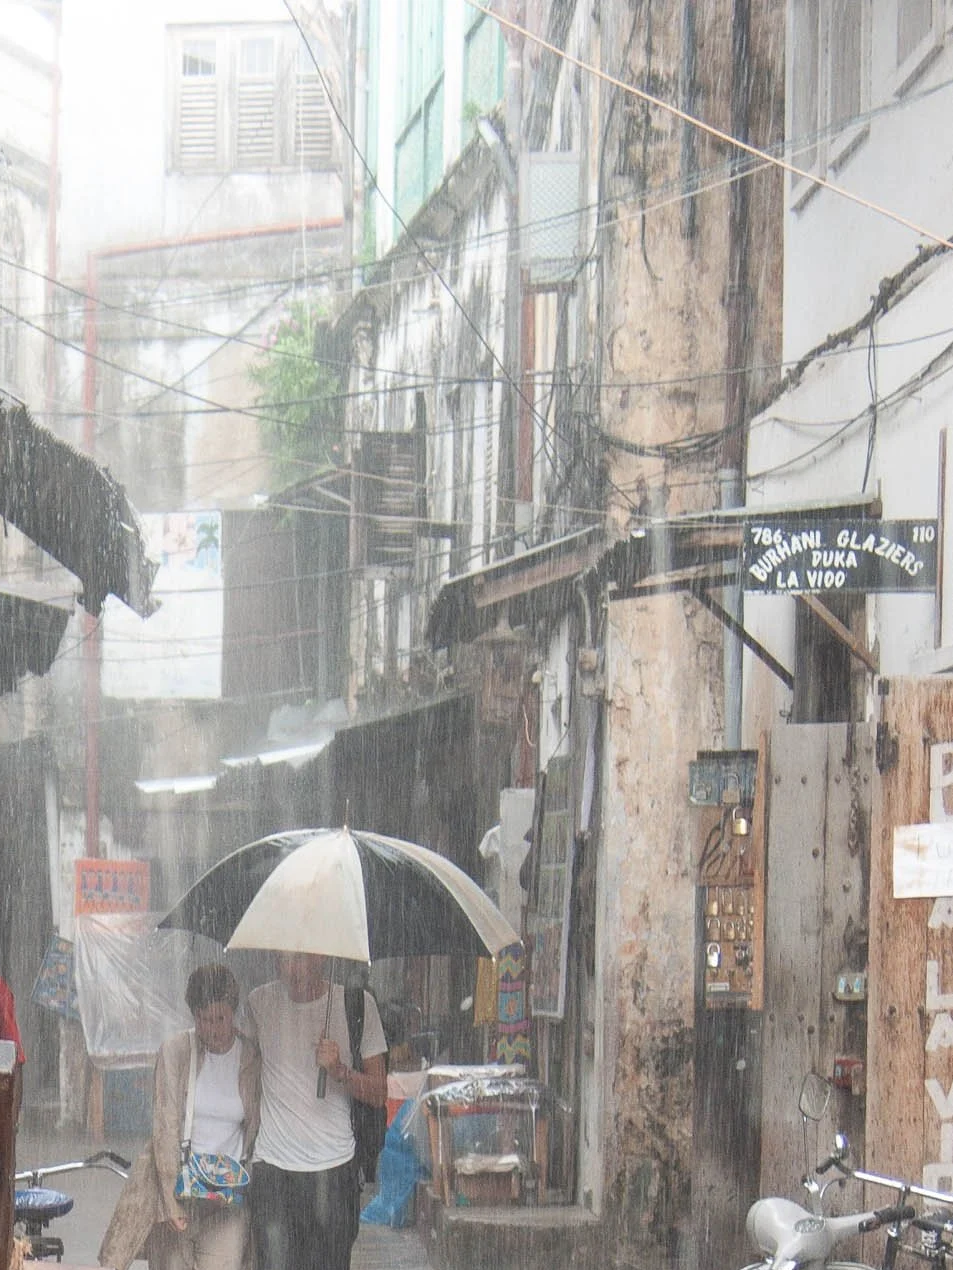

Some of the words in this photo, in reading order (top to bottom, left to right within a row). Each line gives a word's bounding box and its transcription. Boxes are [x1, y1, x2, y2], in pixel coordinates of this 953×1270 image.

[751, 527, 783, 545] 786
[912, 526, 935, 543] 110
[749, 531, 821, 582] BURHANI
[837, 529, 924, 577] GLAZIERS
[811, 550, 858, 569] DUKA
[776, 570, 799, 588] LA
